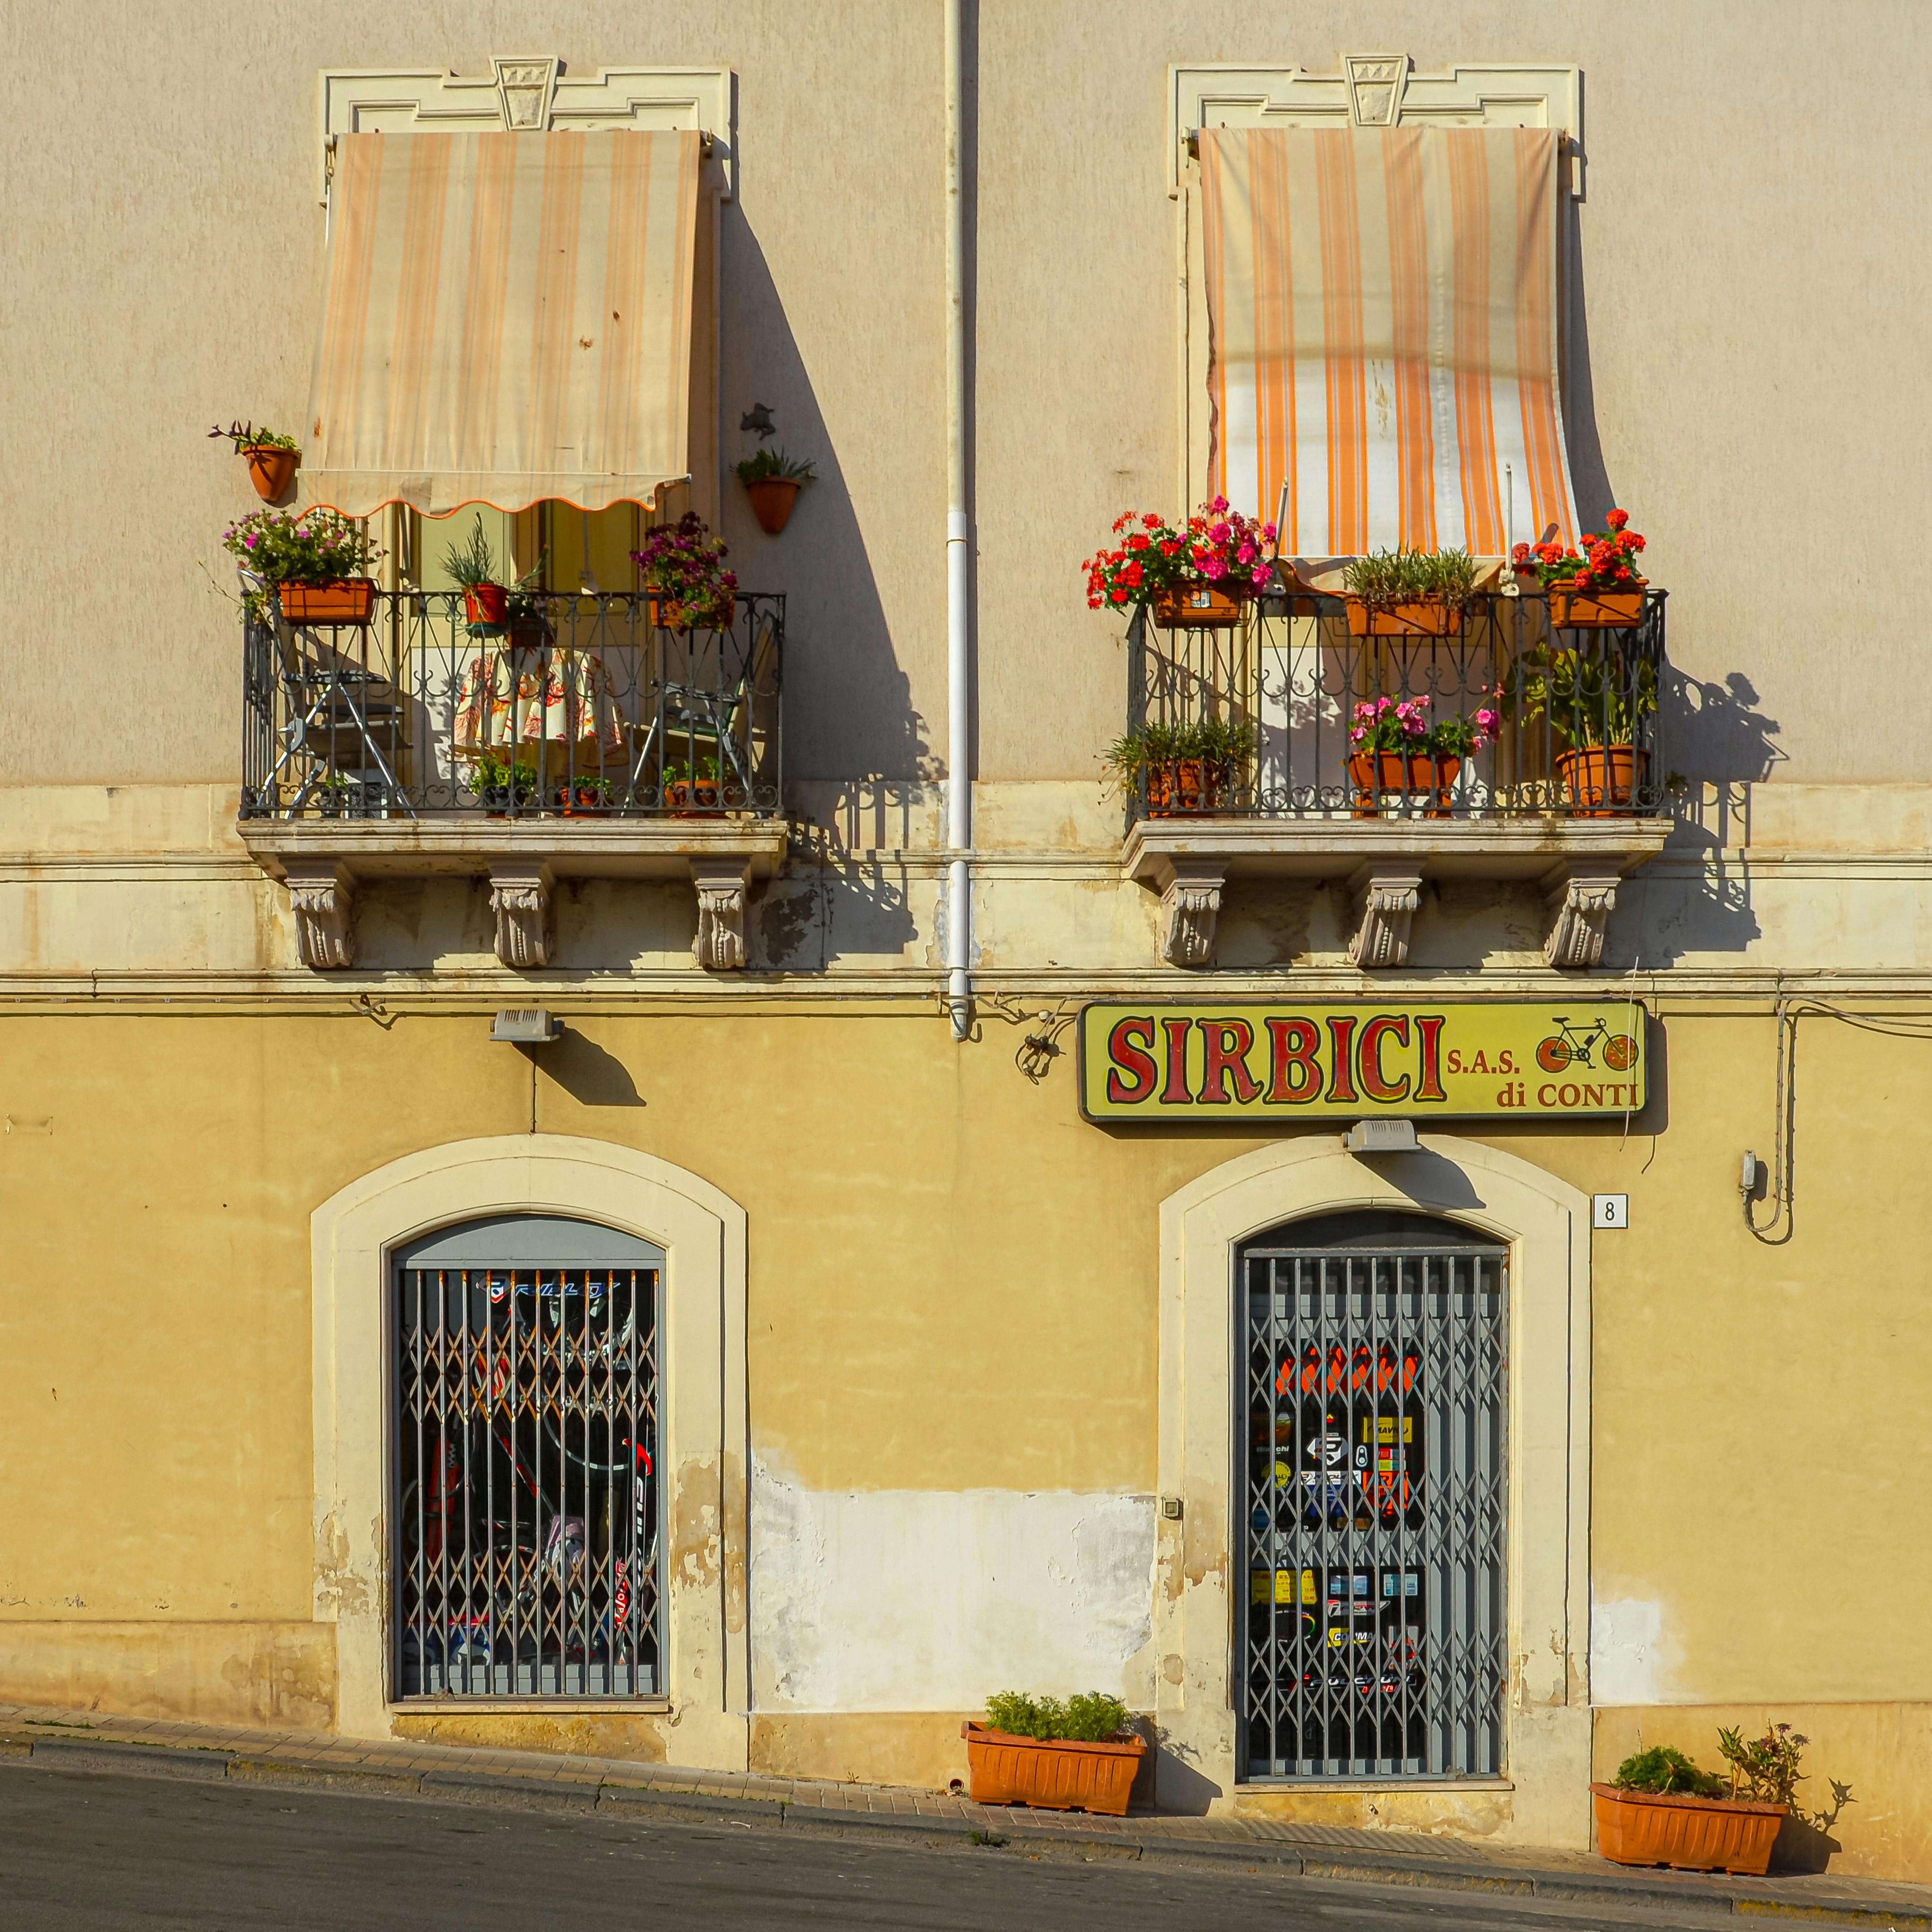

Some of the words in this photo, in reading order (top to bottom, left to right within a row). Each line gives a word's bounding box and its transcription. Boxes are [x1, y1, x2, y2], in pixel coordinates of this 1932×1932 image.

[1106, 1014, 1448, 1105] SIRBICI
[1447, 1049, 1520, 1074] S.A.S.
[1496, 1082, 1527, 1107] di
[1537, 1083, 1639, 1107] CONTI
[1605, 1202, 1615, 1221] 8
